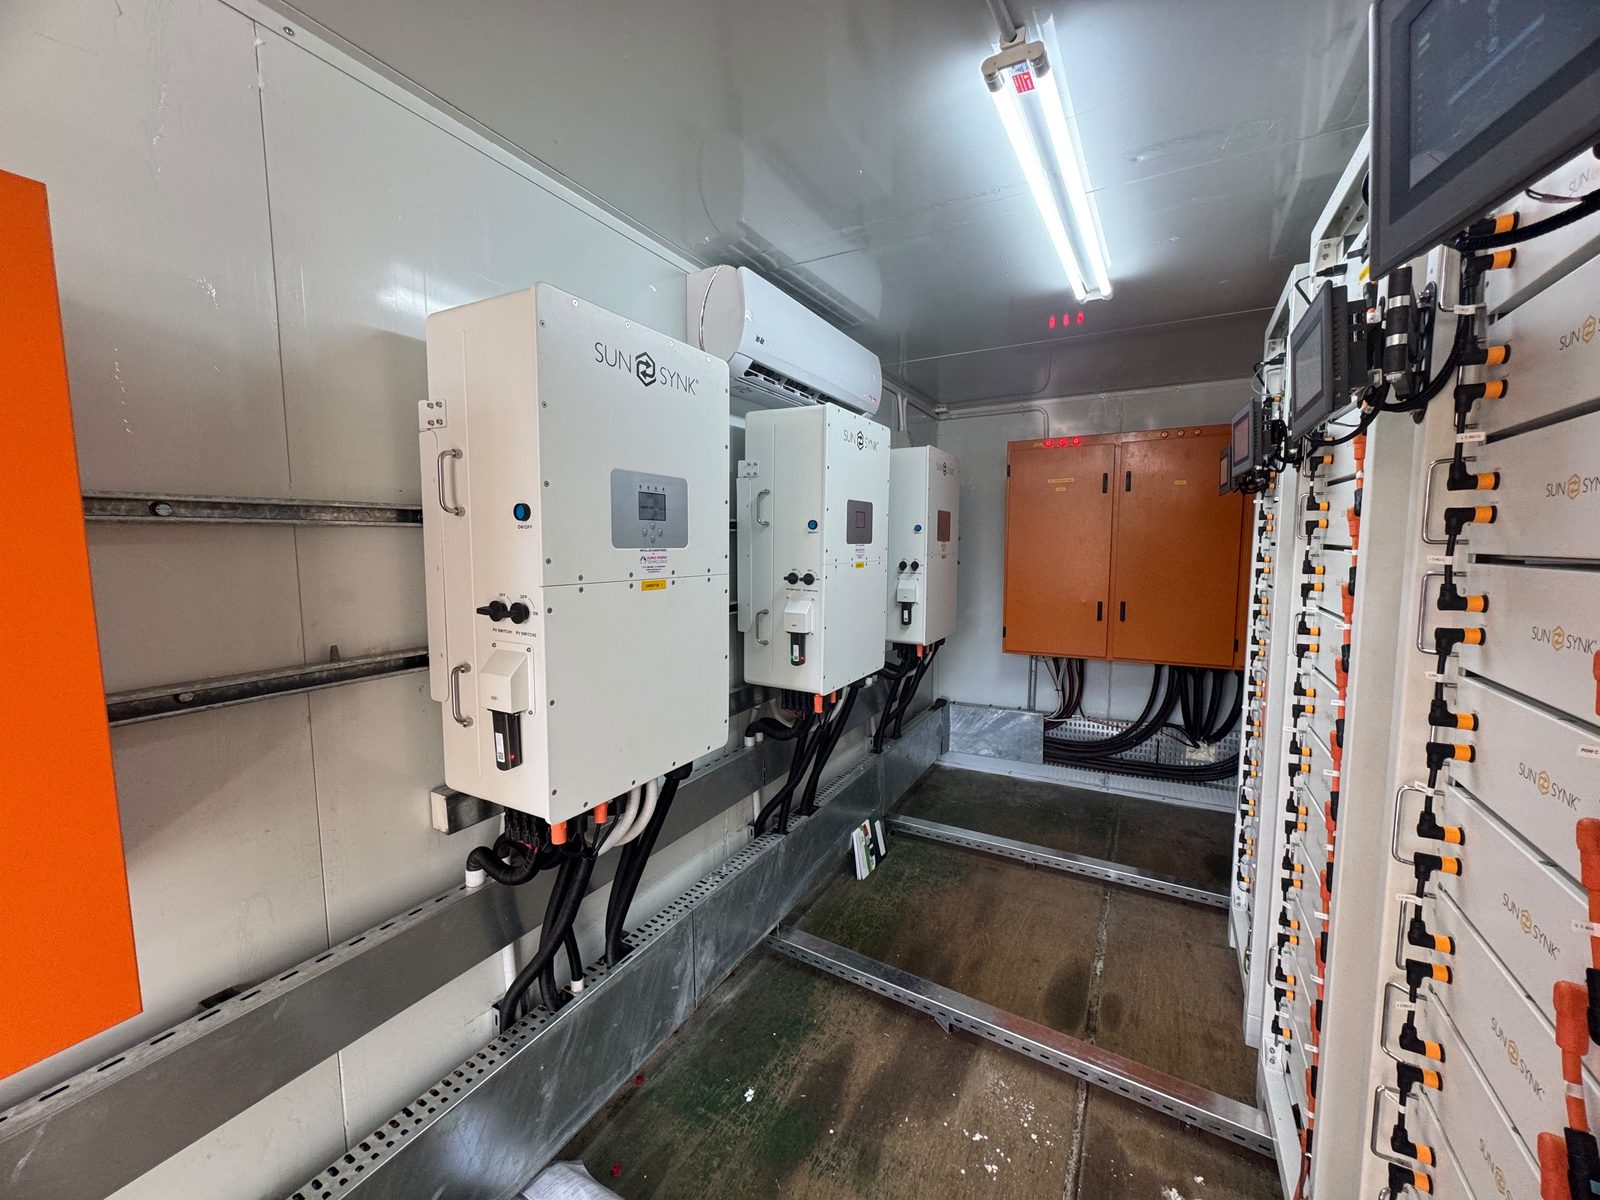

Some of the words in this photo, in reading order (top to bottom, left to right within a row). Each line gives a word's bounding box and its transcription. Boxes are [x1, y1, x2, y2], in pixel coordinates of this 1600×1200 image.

[1559, 327, 1581, 351] SUN
[594, 341, 632, 373] SUN
[660, 366, 696, 395] SYNK
[843, 429, 856, 444] SUN
[1545, 481, 1566, 497] SUN
[1531, 626, 1551, 644] SUN
[1566, 634, 1594, 655] SYNK
[1518, 762, 1537, 785] SUN
[1551, 782, 1579, 811] SYNK
[1502, 892, 1520, 920] SUN
[1533, 924, 1558, 960] SYNK
[1491, 1017, 1508, 1048] SUN
